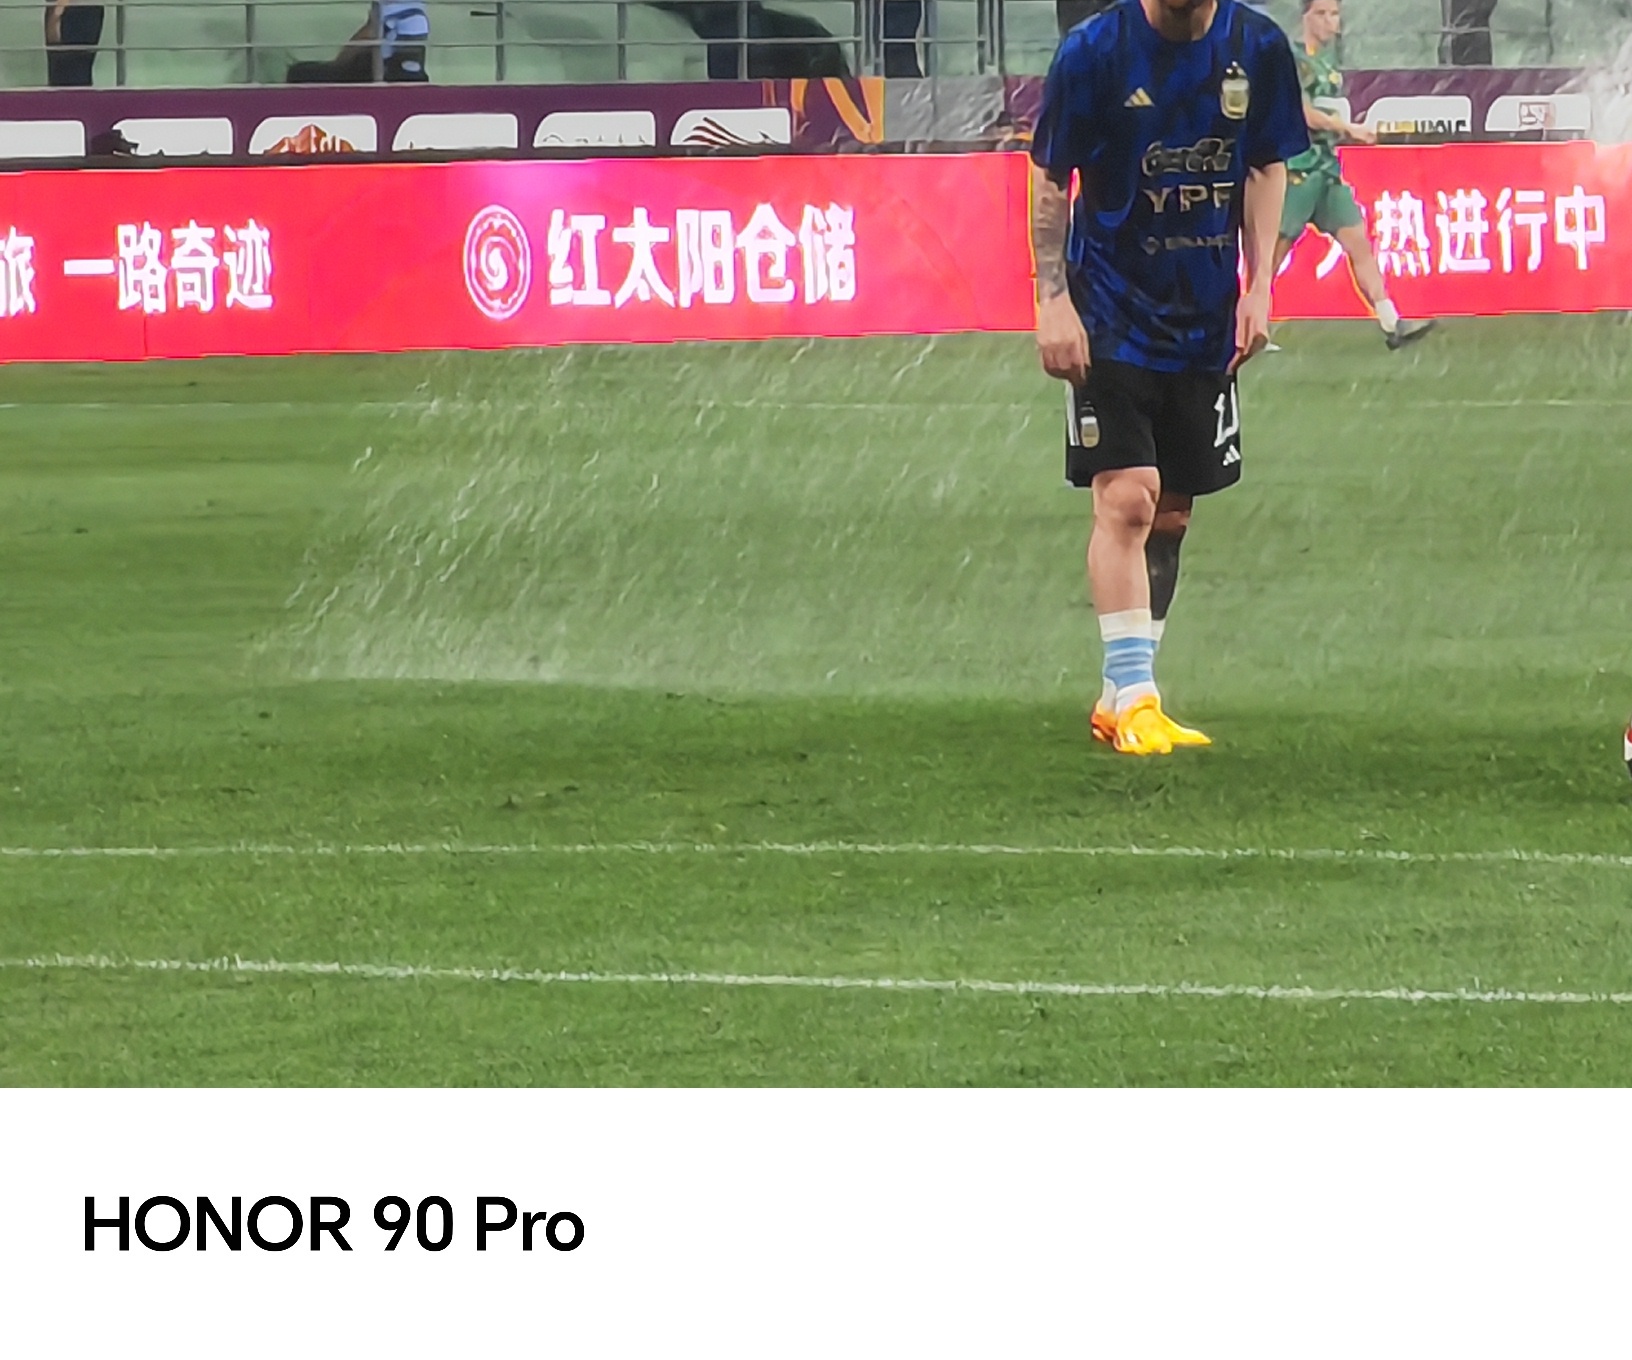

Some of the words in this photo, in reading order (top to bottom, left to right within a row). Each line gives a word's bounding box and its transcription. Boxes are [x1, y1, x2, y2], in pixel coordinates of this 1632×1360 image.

[1142, 181, 1235, 213] YPF
[63, 218, 273, 314] 一路奇迹
[548, 202, 856, 308] 红太阳仓储
